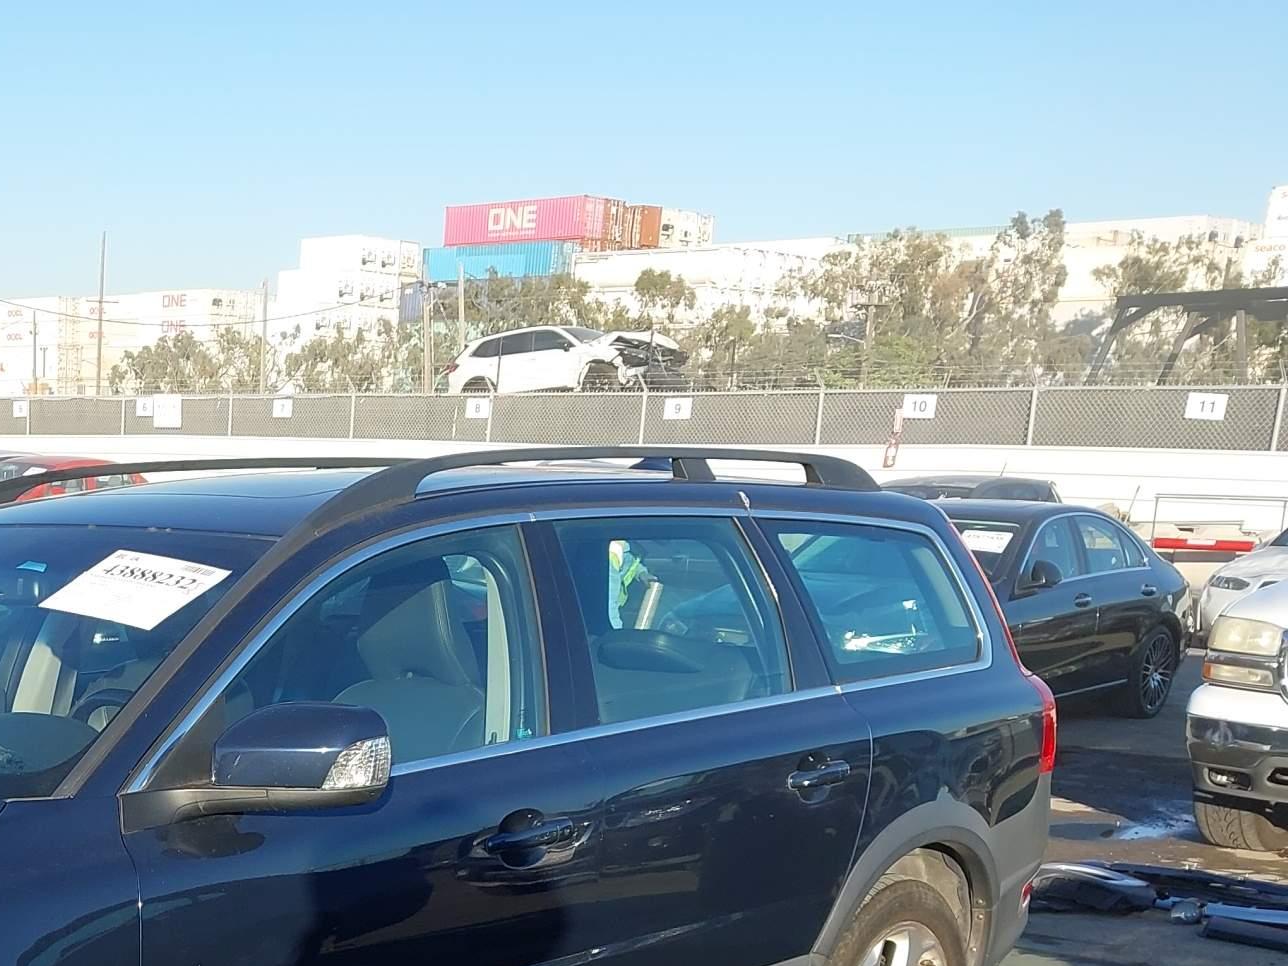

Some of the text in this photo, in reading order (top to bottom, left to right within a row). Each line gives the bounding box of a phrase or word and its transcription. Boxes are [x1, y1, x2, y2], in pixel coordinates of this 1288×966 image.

[488, 205, 537, 230] ONE
[1255, 244, 1286, 252] seaco
[162, 294, 187, 308] ONE
[475, 403, 481, 413] 8
[674, 403, 681, 414] 9
[912, 400, 927, 412] 10
[1200, 400, 1215, 412] 11
[103, 564, 197, 590] 43888232
